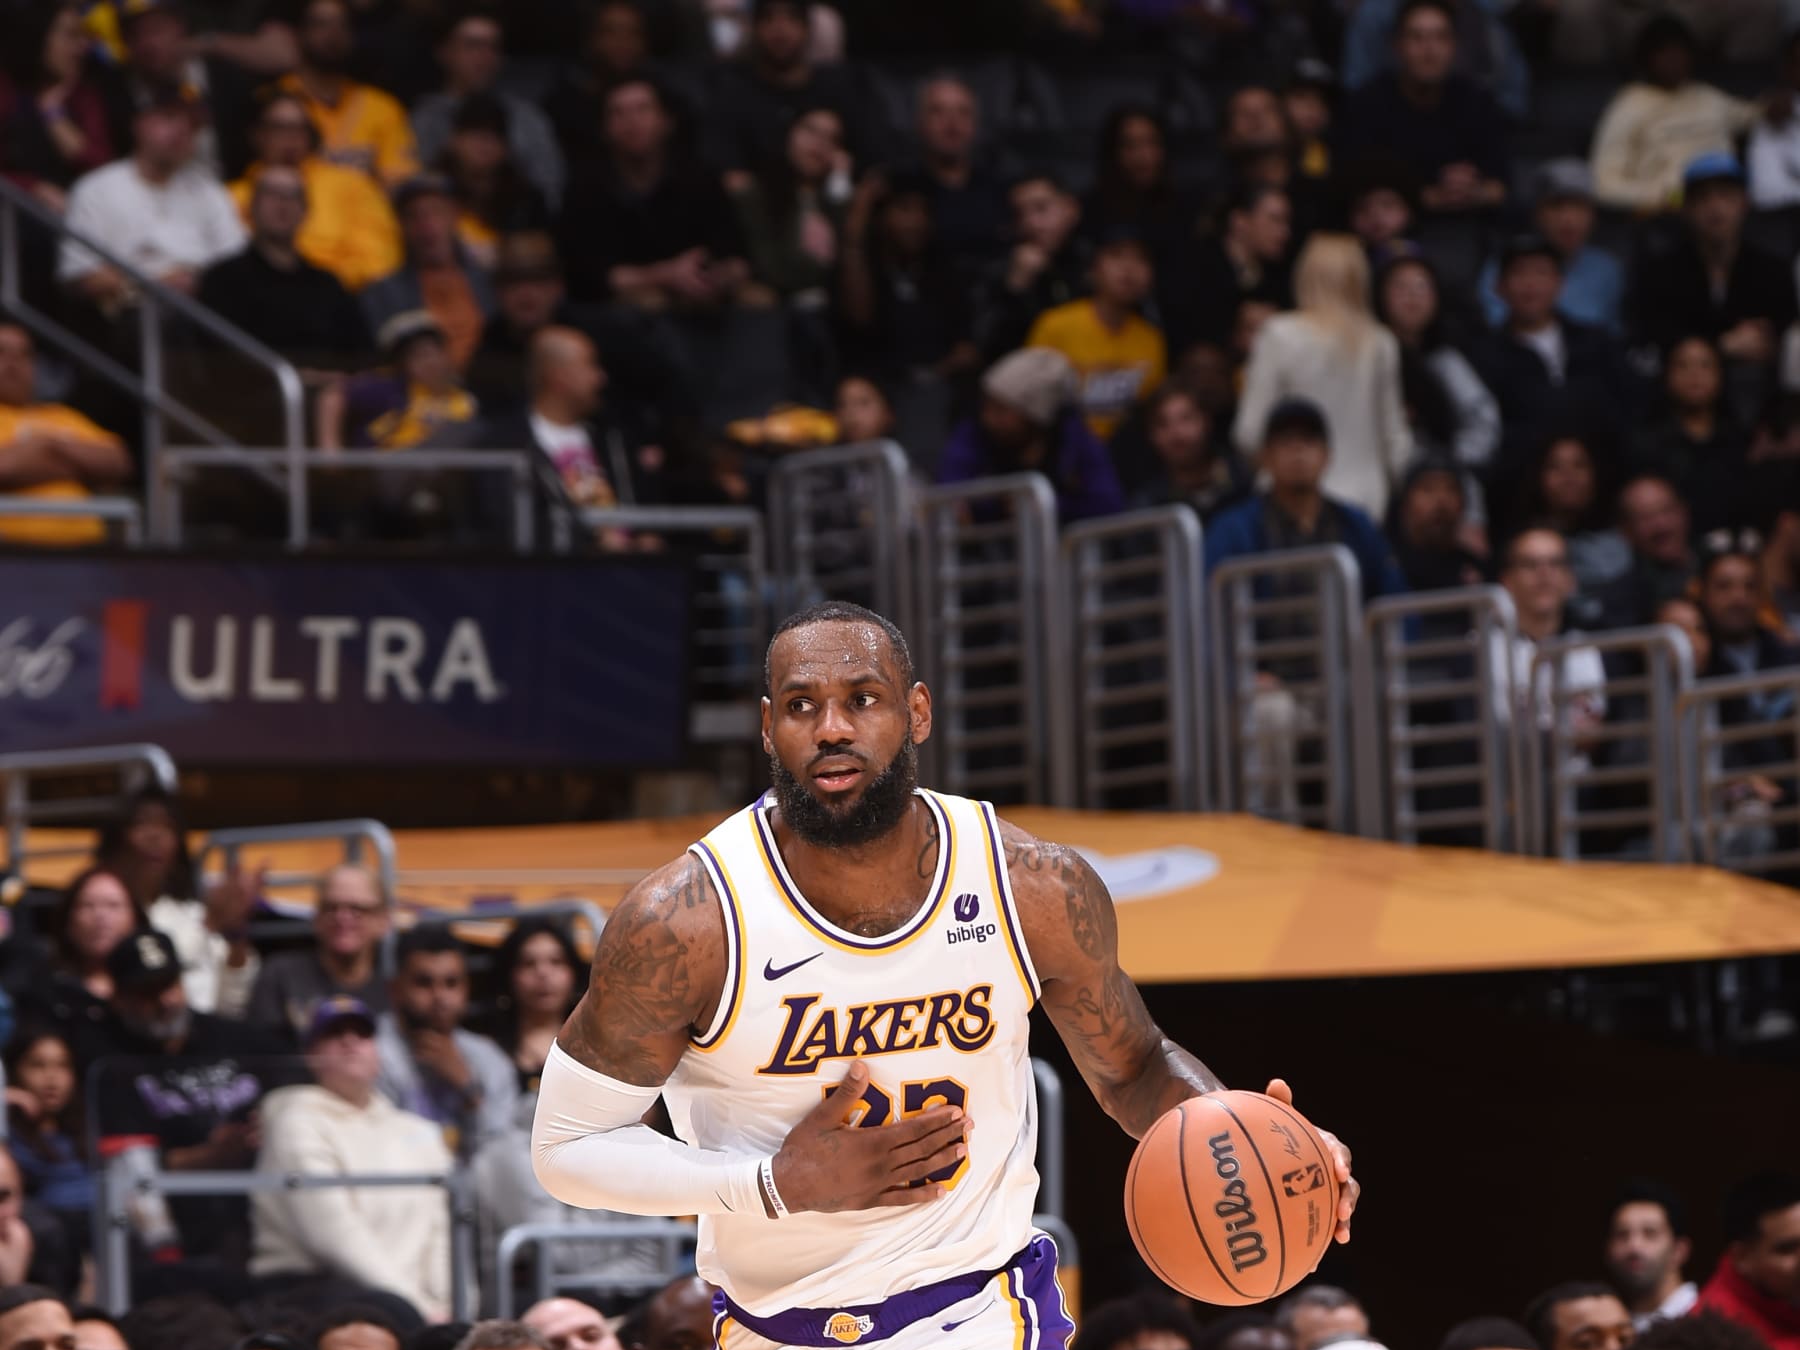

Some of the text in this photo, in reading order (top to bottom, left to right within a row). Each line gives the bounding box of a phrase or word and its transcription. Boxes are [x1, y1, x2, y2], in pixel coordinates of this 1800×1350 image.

[169, 615, 502, 701] ULTRA
[946, 922, 996, 945] bibigo
[755, 983, 997, 1076] LAKERS
[764, 1174, 784, 1212] PROMISE
[1208, 1130, 1269, 1273] Wilson
